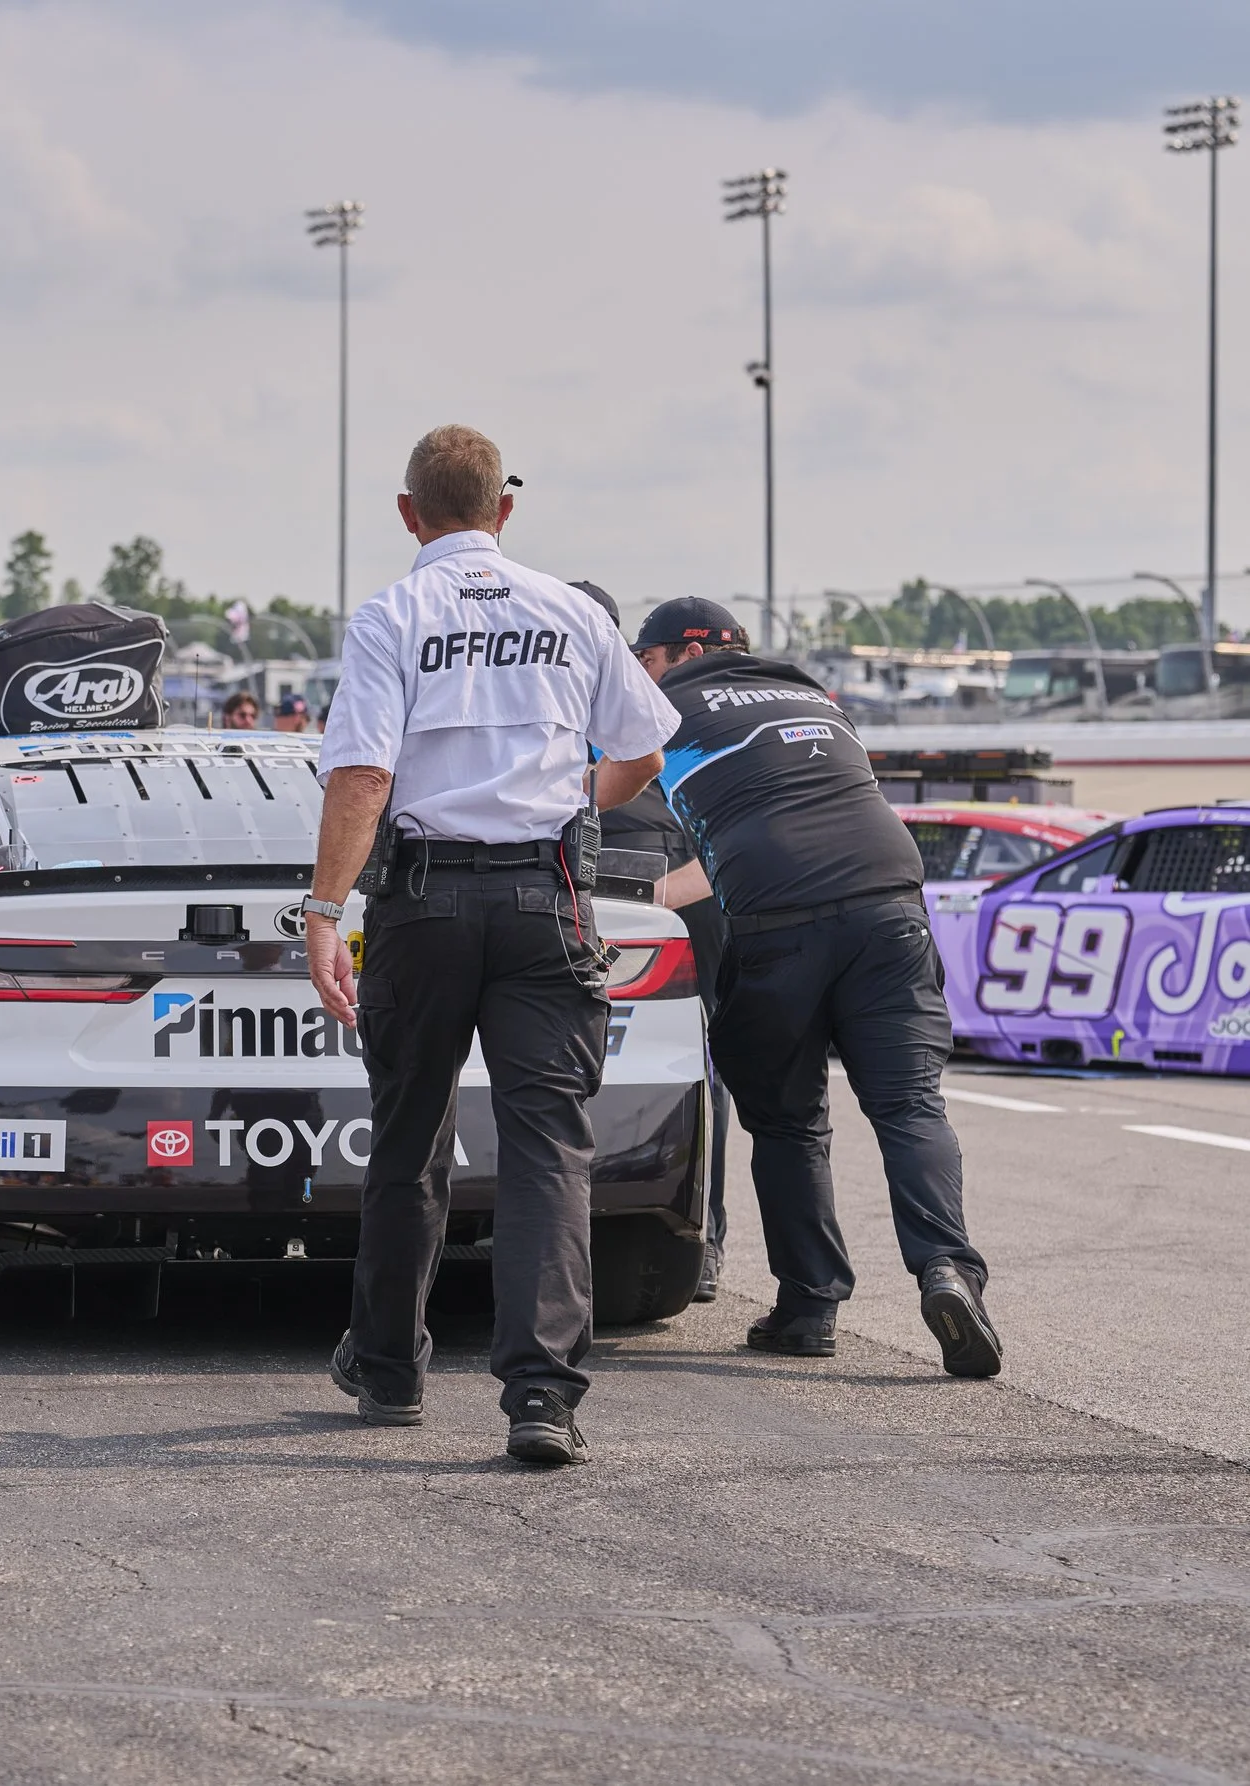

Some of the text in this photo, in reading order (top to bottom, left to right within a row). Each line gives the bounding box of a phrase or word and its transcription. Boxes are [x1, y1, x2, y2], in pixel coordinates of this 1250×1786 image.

[459, 587, 510, 600] NASCAR
[419, 629, 571, 674] OFFICIAL
[33, 669, 132, 705] Arai
[64, 703, 109, 713] HELMET
[30, 721, 69, 732] Racing
[784, 728, 817, 739] Mobil
[141, 950, 309, 961] CAM
[980, 906, 1129, 1018] 99
[153, 989, 363, 1058] Pinna
[204, 1118, 470, 1167] TOYO
